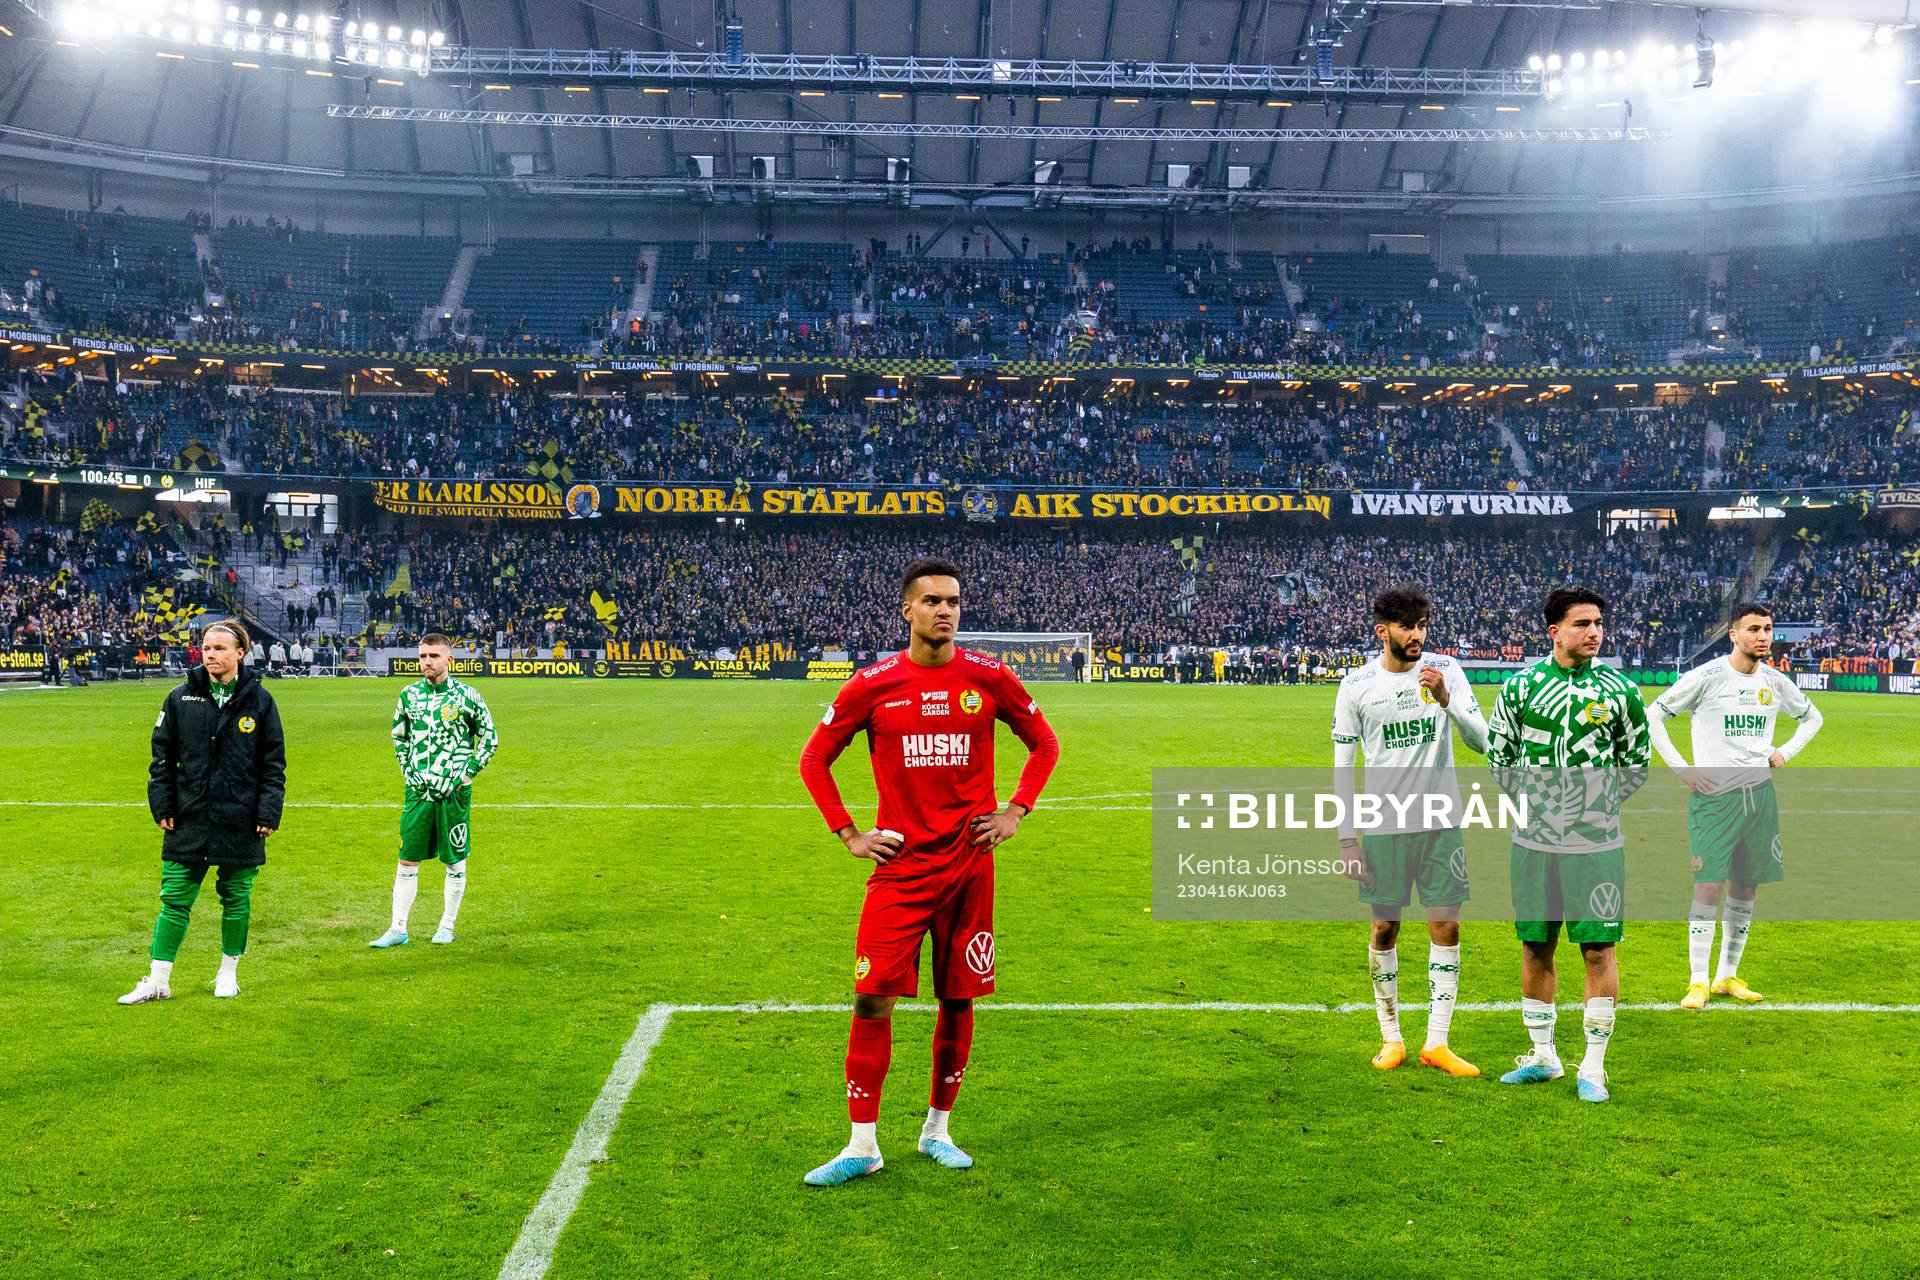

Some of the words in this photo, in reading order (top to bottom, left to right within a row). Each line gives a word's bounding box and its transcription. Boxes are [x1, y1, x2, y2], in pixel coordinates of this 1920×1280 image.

[9, 331, 52, 344] MOBBNING
[72, 337, 107, 350] FRIENDS
[108, 341, 135, 353] ARENA
[611, 361, 662, 370] TILLSAMMAN
[685, 363, 725, 371] MOBBNING
[1860, 364, 1876, 373] MOT
[80, 470, 122, 485] 100:45
[143, 475, 151, 486] 0
[195, 478, 215, 489] HIF
[418, 481, 562, 506] KARLSSON
[615, 487, 751, 513] NORRA
[762, 487, 945, 515] STÅPLATS
[1738, 496, 1759, 507] AIK
[418, 506, 433, 516] DE
[437, 506, 502, 518] SVARTGULA
[507, 508, 562, 519] SAGORNA
[1010, 493, 1083, 518] AIK
[1091, 494, 1331, 520] STOCKHOLM
[1350, 493, 1430, 515] IVAN
[1446, 494, 1573, 516] TURINA
[1501, 645, 1524, 655] FREE
[488, 661, 584, 676] TELEOPTION.
[747, 661, 770, 671] TAK
[863, 657, 899, 679] sesol
[963, 653, 1001, 670] sesol
[1796, 673, 1829, 690] UNIBET
[1382, 716, 1437, 741] HUSKI
[1724, 714, 1767, 730] HUSKI
[902, 733, 970, 757] HUSKI
[1385, 734, 1437, 750] CHOCOLATE
[904, 756, 969, 768] CHOCOLATE
